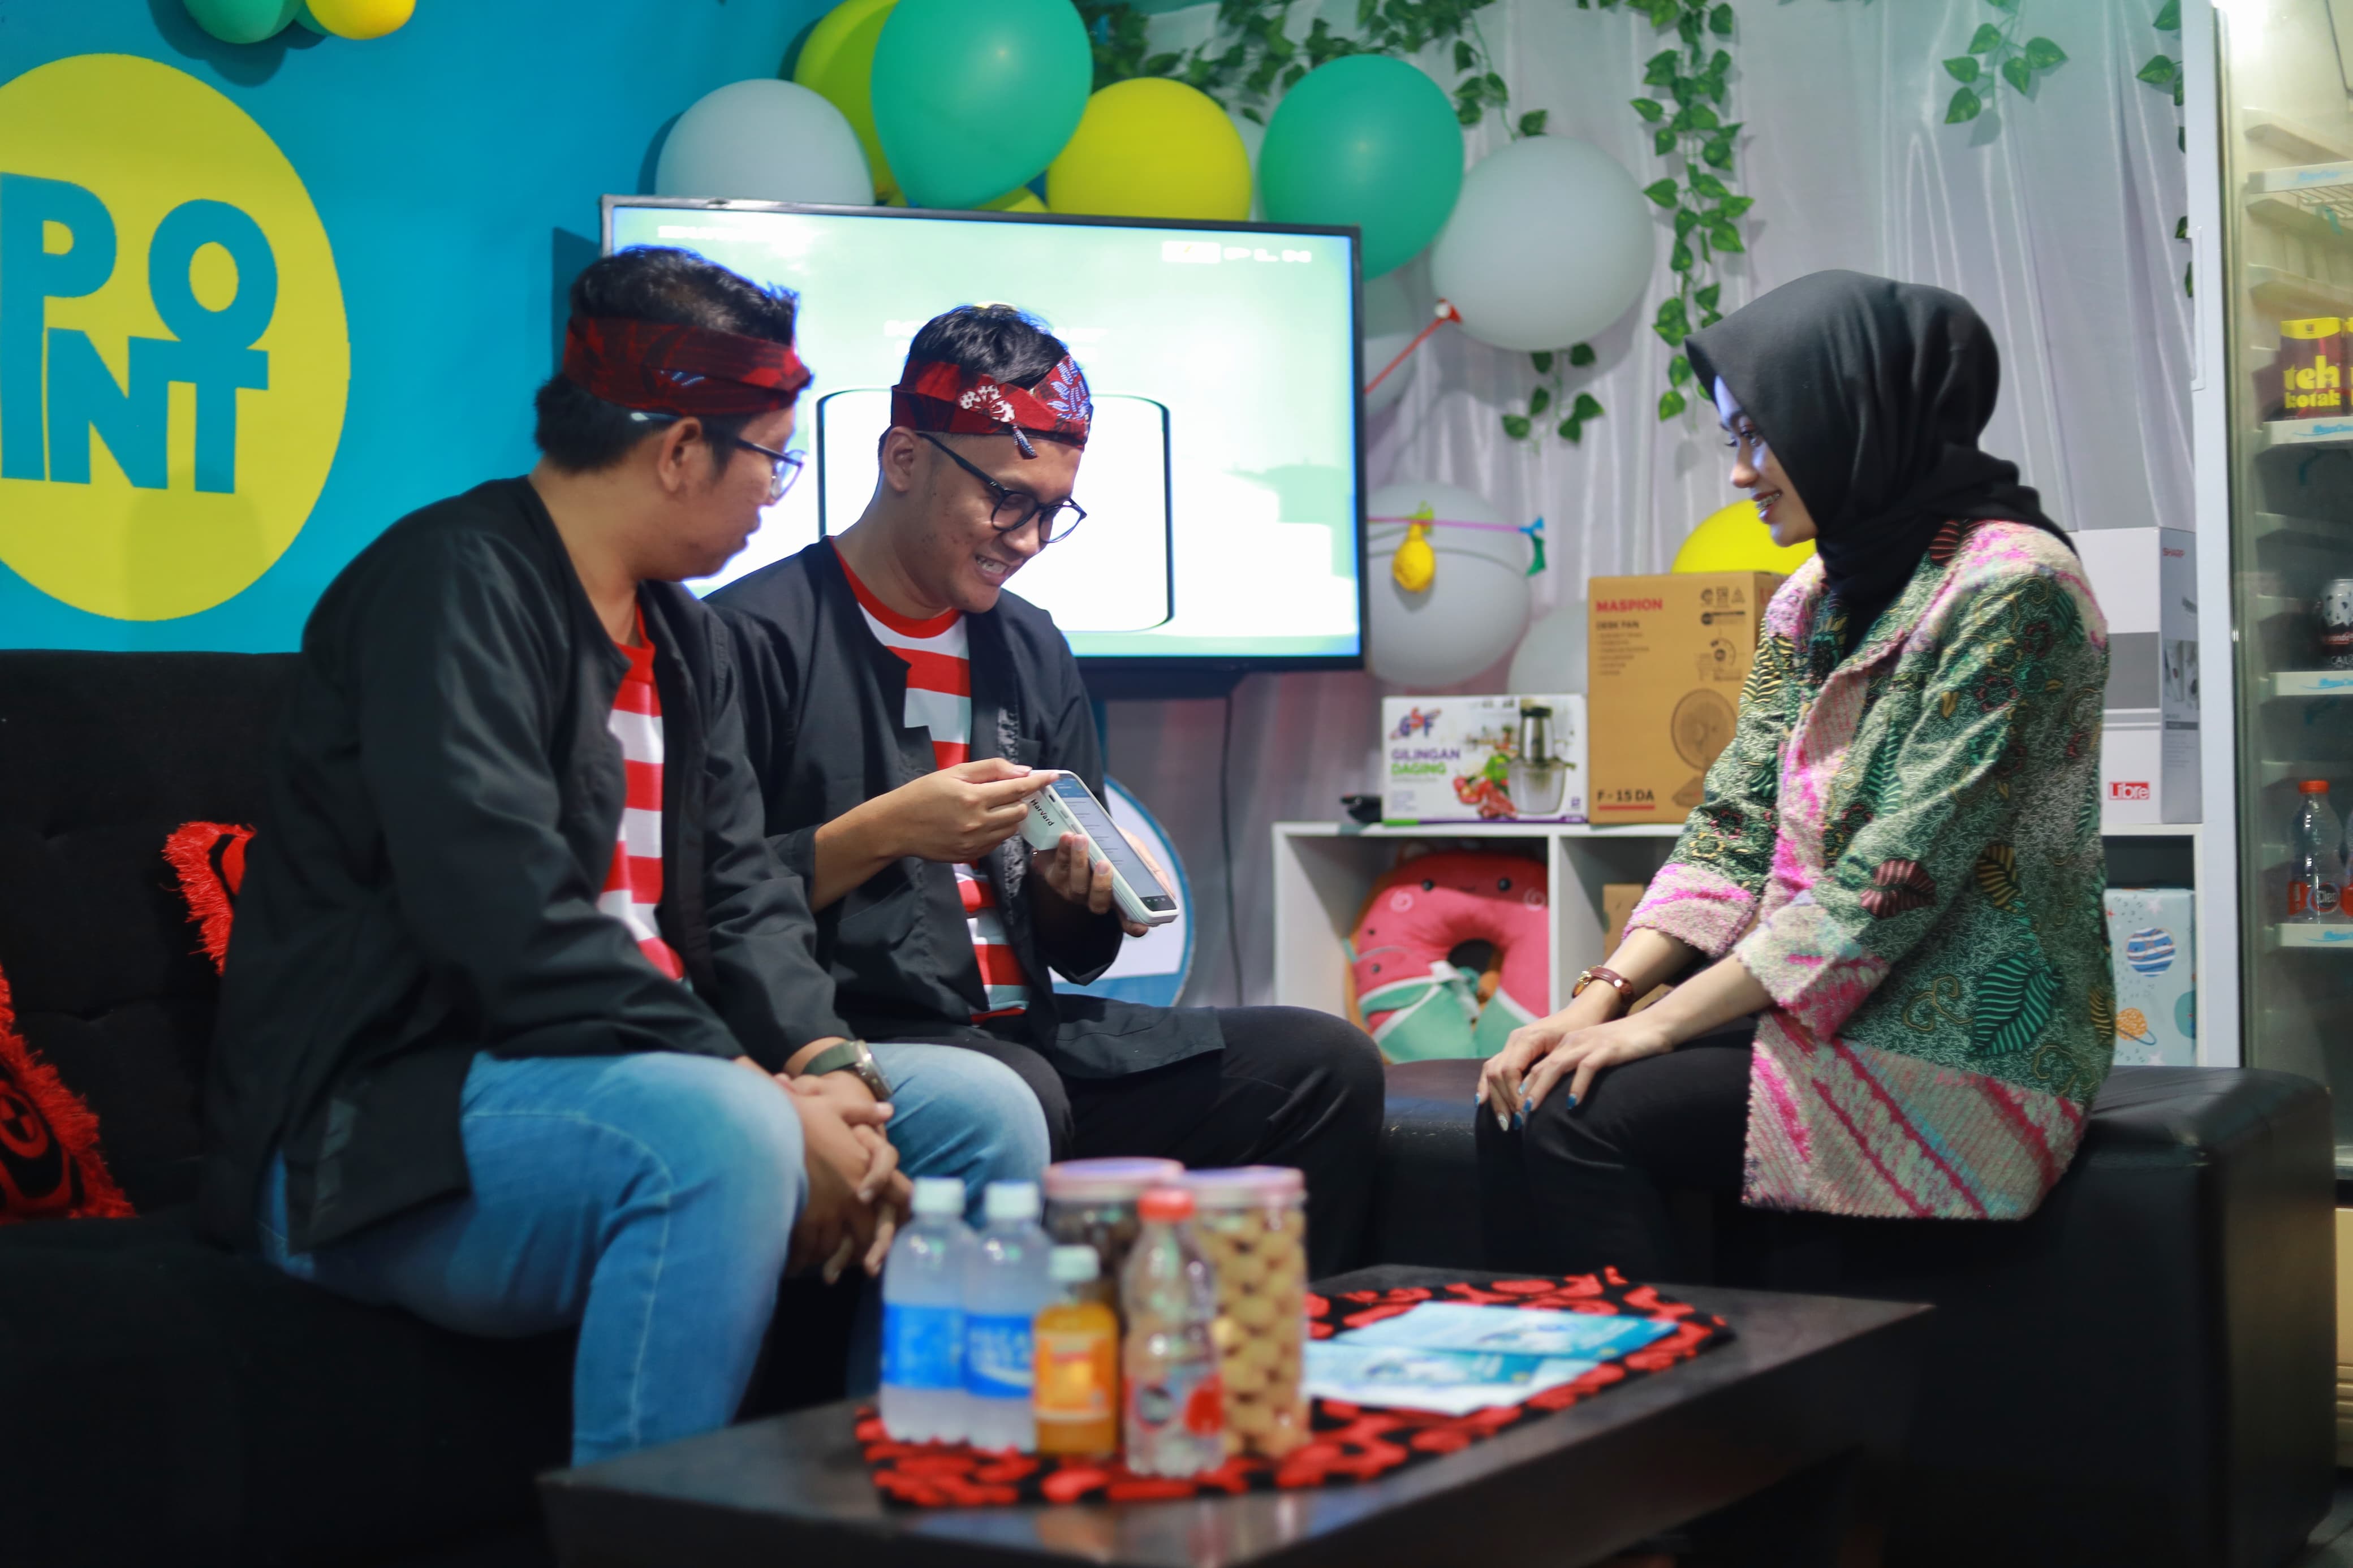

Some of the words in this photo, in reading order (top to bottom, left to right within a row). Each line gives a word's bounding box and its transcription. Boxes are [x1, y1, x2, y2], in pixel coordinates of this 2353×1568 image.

[2283, 355, 2340, 390] teh
[2285, 389, 2341, 408] kotak
[1596, 598, 1663, 612] MASPION
[1391, 748, 1460, 761] GILINGAN
[1391, 762, 1447, 775] DAGING
[1635, 789, 1654, 801] DA
[2108, 782, 2149, 799] Libre
[1031, 799, 1055, 827] Harvard
